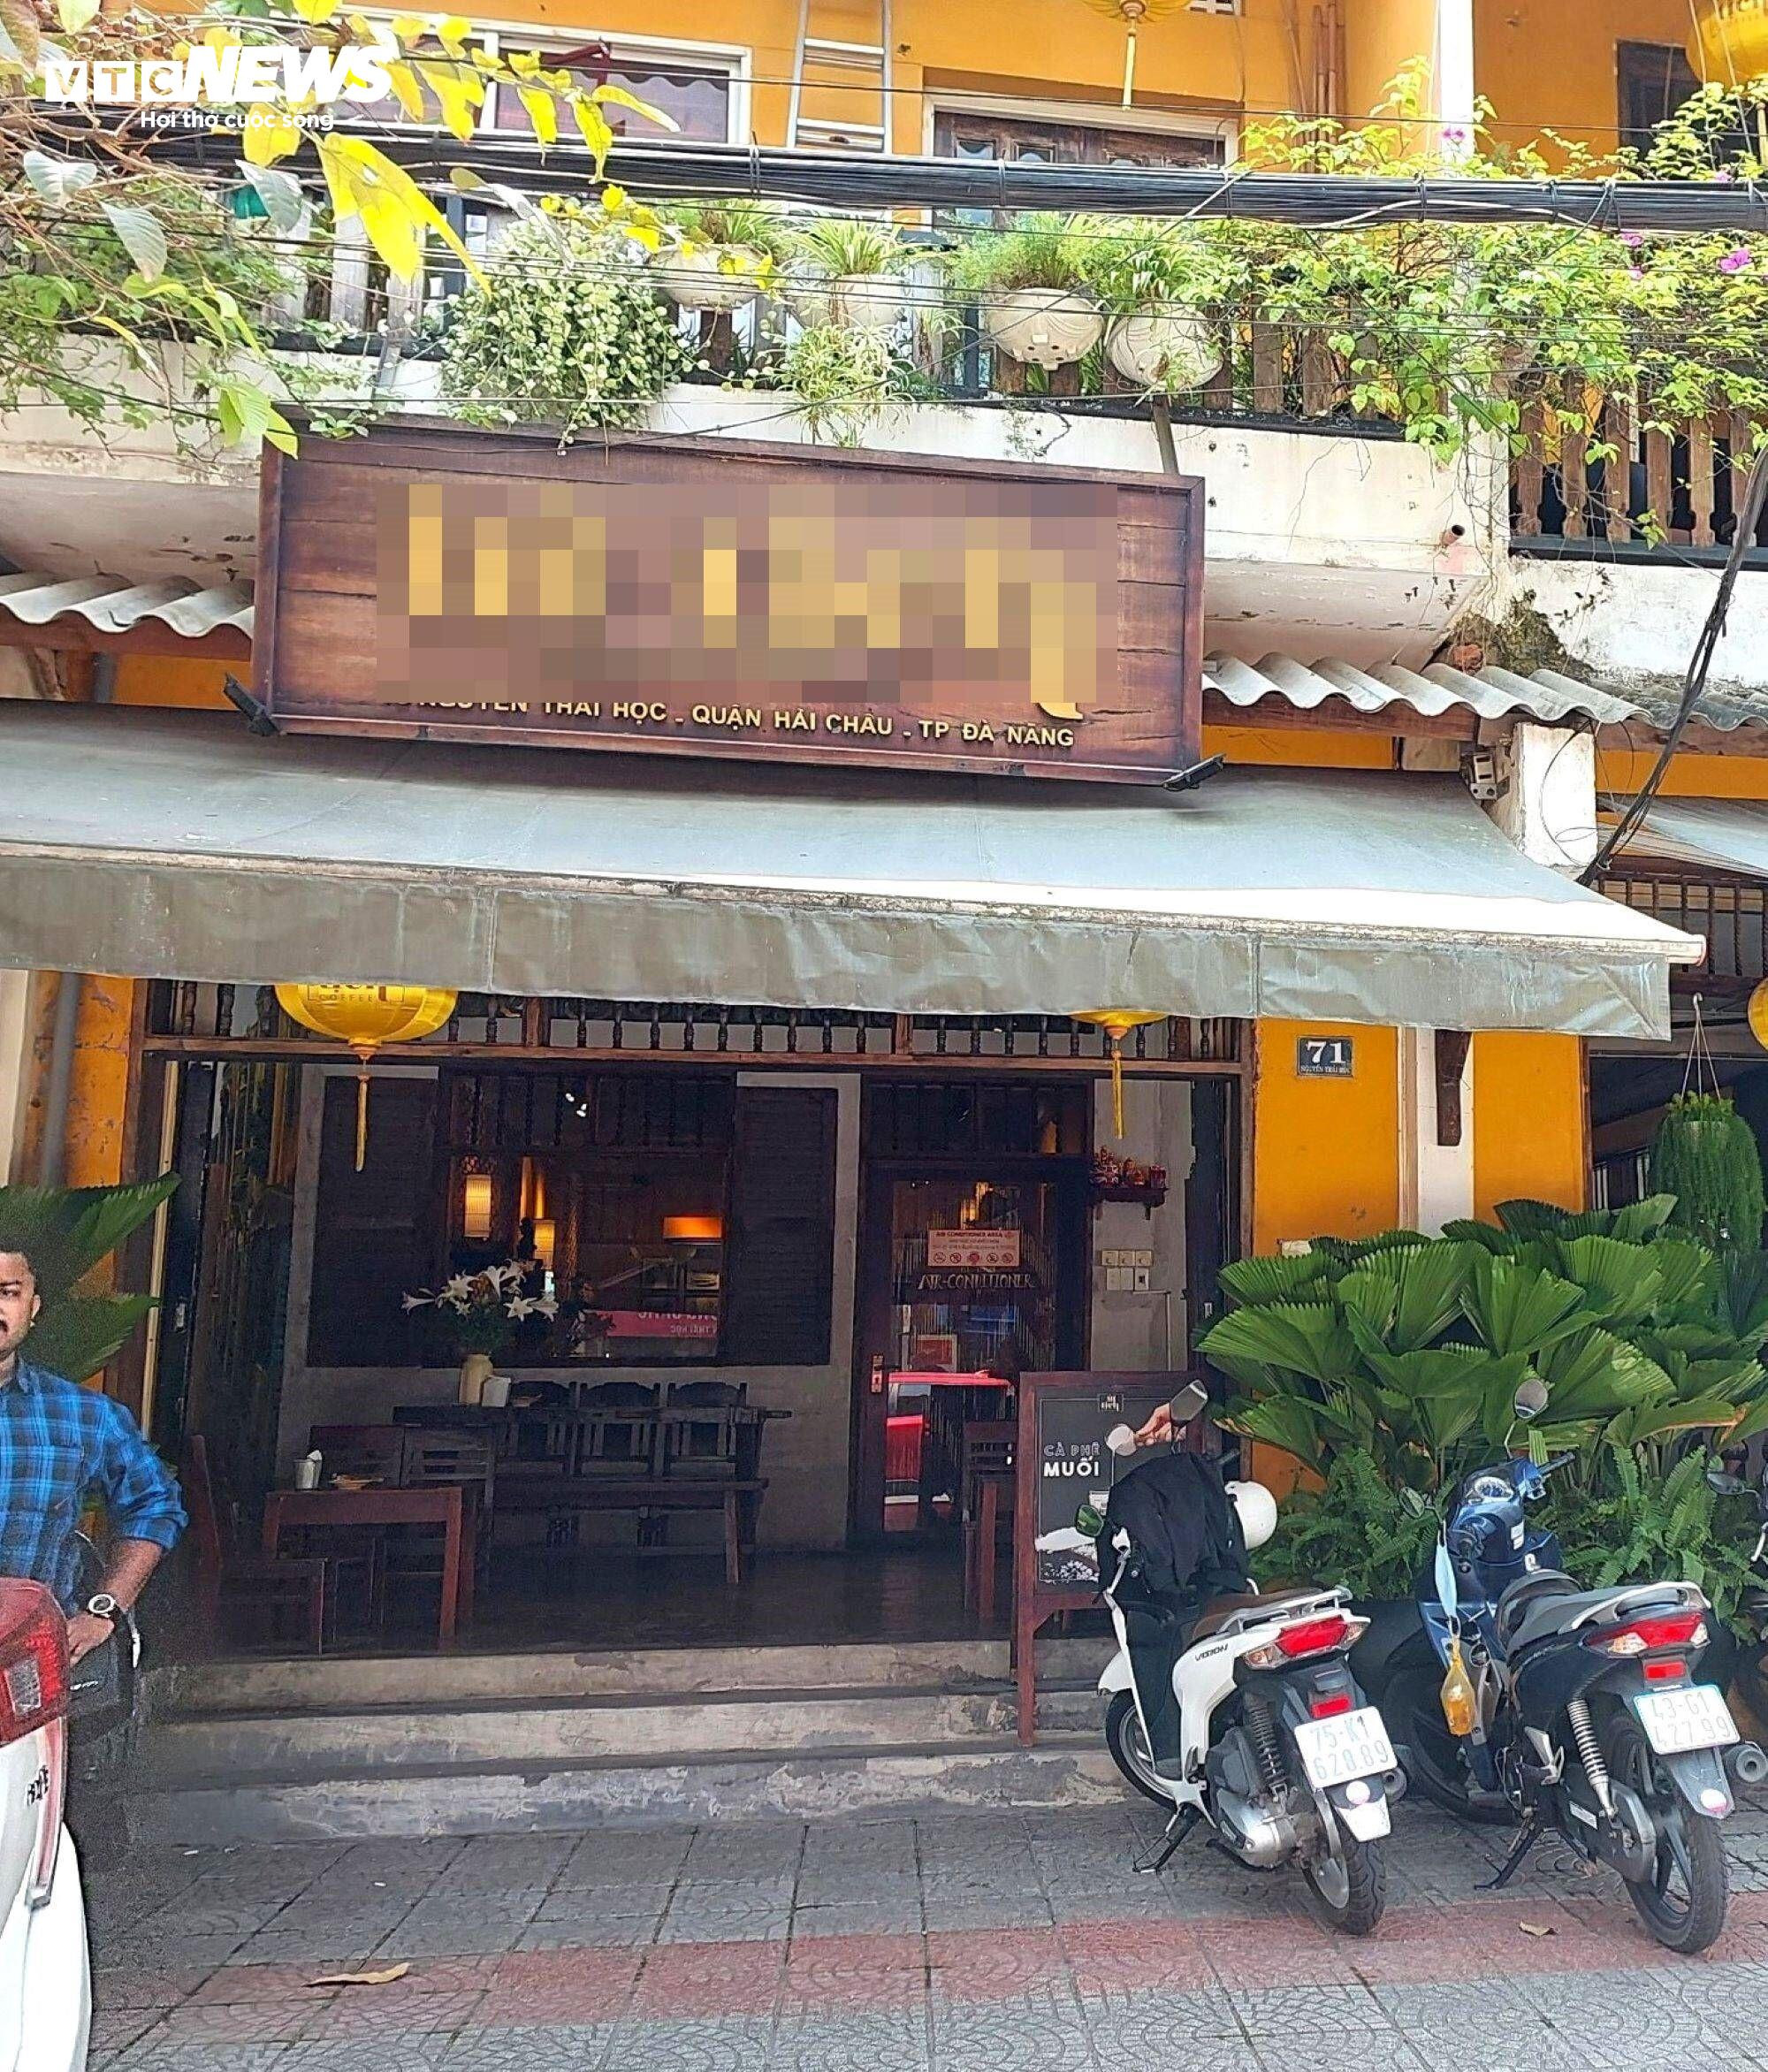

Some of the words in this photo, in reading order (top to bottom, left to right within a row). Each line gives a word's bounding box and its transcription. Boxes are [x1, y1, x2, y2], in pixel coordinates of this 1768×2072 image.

[613, 702, 667, 725] HỌC
[691, 705, 762, 731] QUẬN
[774, 708, 816, 731] HẢI
[826, 712, 893, 735] CHÂU
[918, 720, 949, 739] TP
[962, 719, 994, 743] ĐÀ
[1305, 1040, 1346, 1064] 71
[1043, 1441, 1066, 1457] CÀ
[1071, 1441, 1101, 1457] PHÊ
[1043, 1455, 1100, 1477] MUỐI
